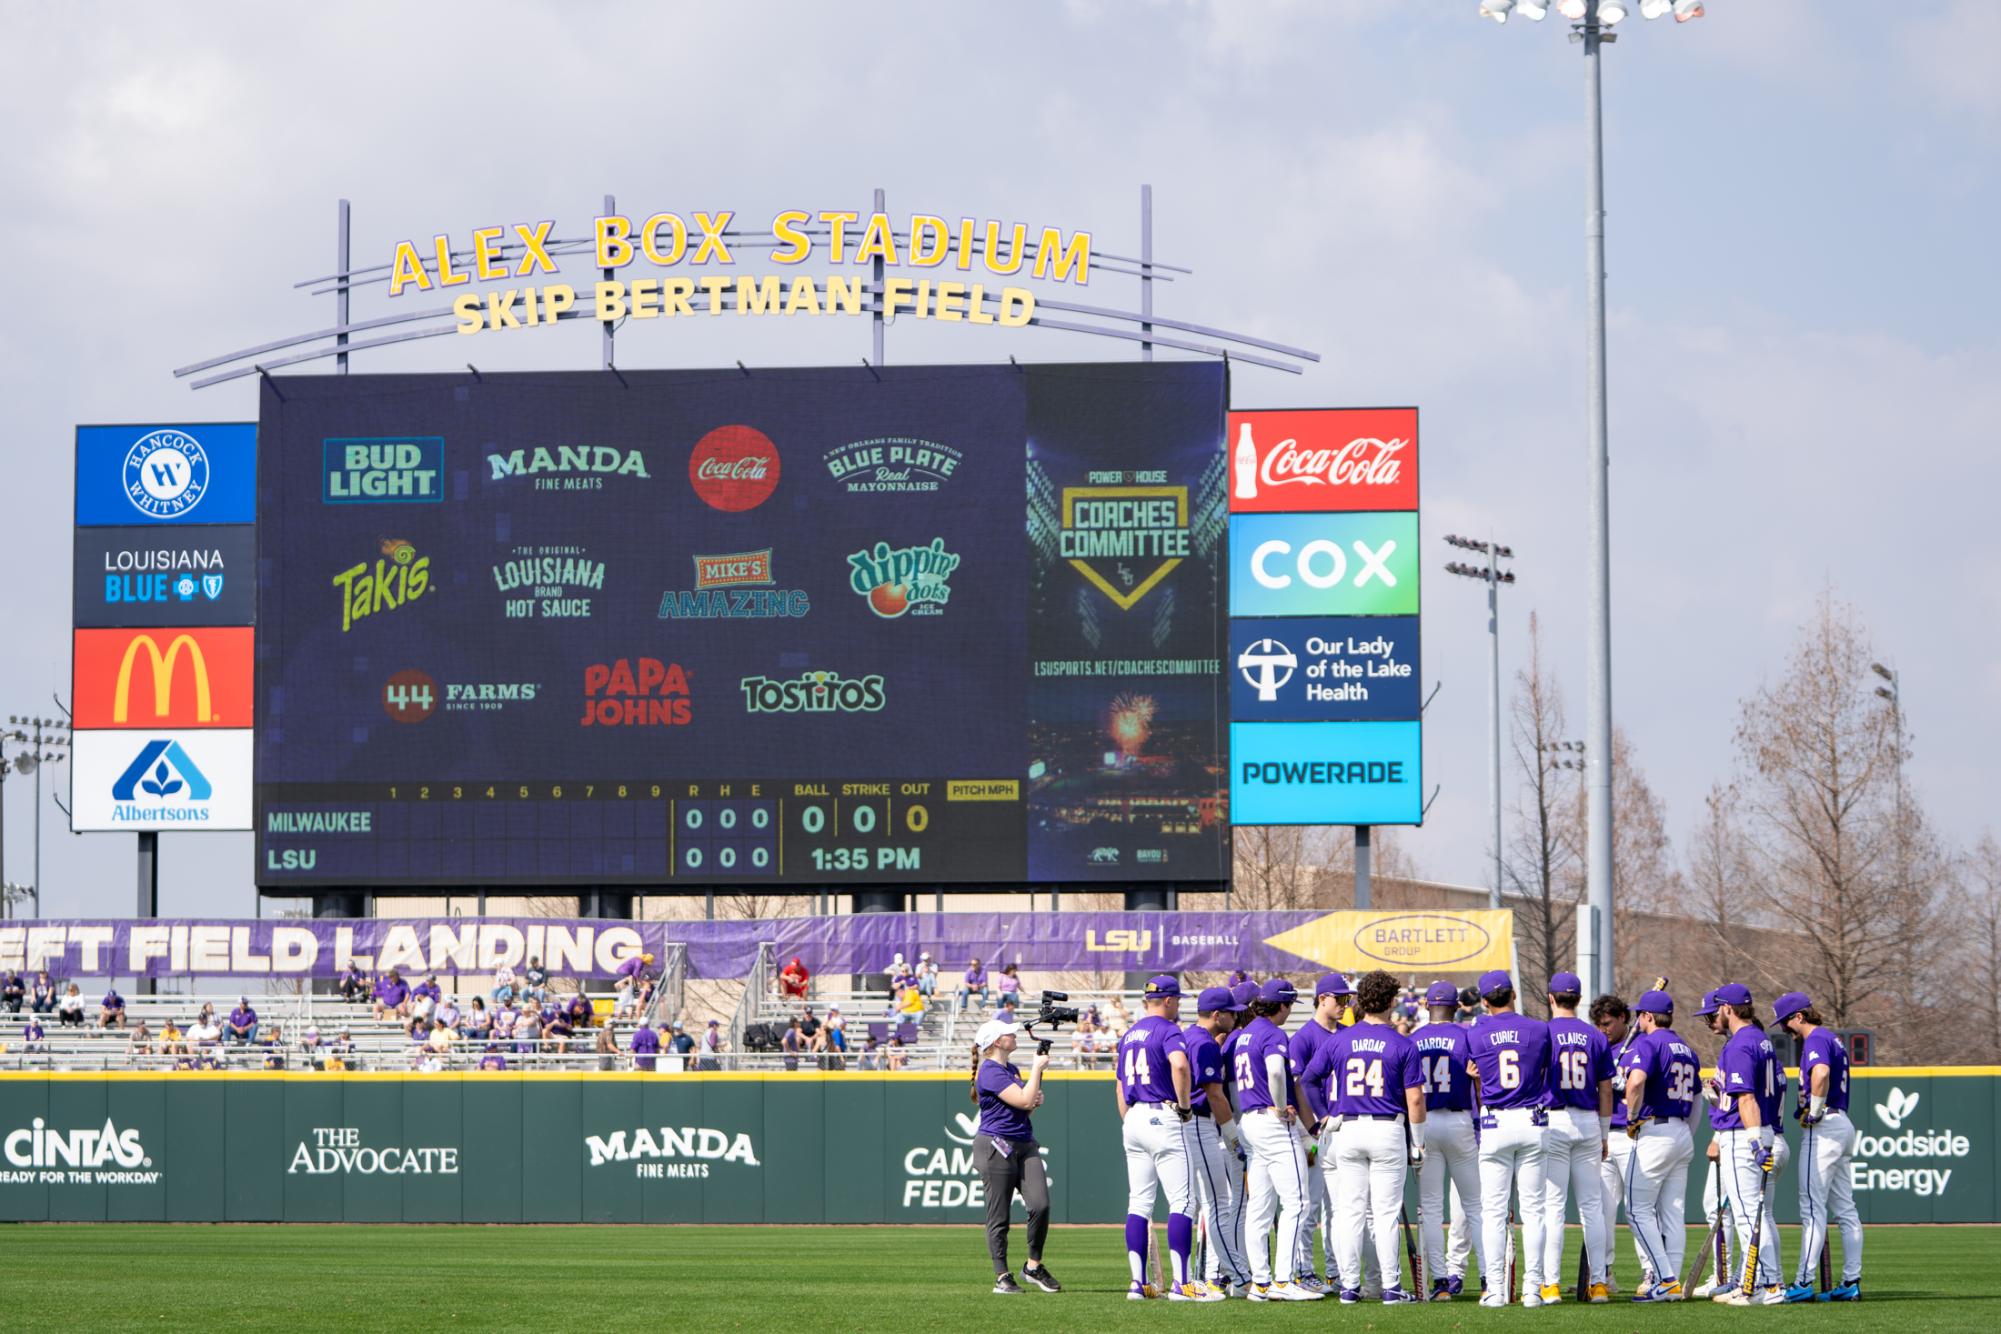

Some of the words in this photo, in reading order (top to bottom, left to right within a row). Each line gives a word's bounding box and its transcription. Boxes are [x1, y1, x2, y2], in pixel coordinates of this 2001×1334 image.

[388, 220, 560, 298] ALEX
[593, 211, 735, 270] BOX
[770, 210, 1093, 287] STADIUM
[452, 284, 576, 335] SKIP
[595, 275, 862, 321] BERTMAN
[883, 279, 1035, 327] FIELD
[129, 434, 202, 469] HANCOCK
[345, 444, 421, 470] BUD
[848, 439, 885, 449] ORLEANS
[920, 440, 963, 458] TRADITION
[487, 446, 646, 480] MANDA
[698, 456, 769, 480] Coca-Cola
[827, 447, 884, 478] BLUE
[890, 446, 958, 476] PLATE
[875, 466, 911, 481] Real
[1261, 438, 1409, 486] Coca-Cola
[330, 470, 435, 496] LIGHT
[535, 478, 562, 490] FINE
[564, 477, 602, 489] MEATS
[847, 481, 939, 492] MAYONNAISE
[1088, 471, 1122, 483] POWER
[1135, 471, 1167, 482] HOUSE
[129, 480, 202, 513] WHITNEY
[1075, 501, 1176, 528] COACHES
[518, 546, 533, 555] THE
[539, 546, 580, 554] ORIGINAL
[1060, 529, 1190, 557] COMMITTEE
[105, 549, 224, 571] LOUISIANA
[705, 561, 761, 579] MIKE'S
[1250, 539, 1398, 590] COX
[493, 557, 605, 592] LOUISIANA
[105, 574, 167, 602] BLUE
[534, 586, 562, 597] BRAND
[905, 581, 951, 604] dots
[506, 600, 535, 617] HOT
[542, 599, 591, 617] SAUCE
[657, 589, 810, 619] AMAZING
[1306, 637, 1343, 655] Our
[1348, 635, 1394, 659] Lady
[584, 657, 691, 696] PAPA
[1034, 659, 1220, 677] LSUSPORTS.NET/COACHESCOMMITTEE
[1306, 660, 1327, 677] of
[1331, 660, 1363, 677] the
[1367, 659, 1412, 677] Lake
[387, 685, 433, 710] 44
[446, 684, 535, 700] FARMS
[1306, 682, 1368, 701] Health
[580, 698, 693, 726] JOHNS
[1243, 761, 1403, 784] POWERADE
[390, 787, 397, 798] 1
[421, 787, 429, 799] 2
[453, 787, 462, 798] 3
[486, 787, 495, 798] 4
[520, 786, 528, 798] 5
[553, 786, 562, 798] 6
[586, 785, 593, 797] 7
[618, 785, 627, 797] 8
[651, 785, 660, 797] 9
[689, 785, 699, 797] R
[720, 785, 730, 796] H
[752, 784, 760, 796] E
[794, 784, 829, 796] BALL
[842, 783, 890, 796] STRIKE
[901, 783, 930, 795] OUT
[953, 784, 985, 796] PITCH
[988, 784, 1014, 795] MPH
[111, 804, 209, 823] Albertsons
[268, 812, 371, 833] MILWAUKEE
[686, 808, 702, 829] 0
[720, 808, 736, 829] 0
[752, 808, 768, 828] 0
[802, 805, 825, 833] 0
[853, 805, 876, 832] 0
[906, 804, 929, 832] 0
[268, 850, 316, 870] LSU
[686, 847, 702, 868] 0
[720, 847, 736, 868] 0
[752, 847, 768, 867] 0
[812, 847, 869, 870] 1:35
[878, 847, 920, 869] PM
[1086, 930, 1151, 951] LSU
[1172, 935, 1239, 945] BASEBALL
[1375, 929, 1468, 942] BARTLETT
[129, 926, 319, 972] FIELD
[335, 924, 643, 974] LANDING
[1384, 947, 1421, 956] GROUP
[1352, 1038, 1386, 1053] DARDAR
[1416, 1037, 1455, 1052] HARDEN
[1490, 1031, 1520, 1046] CURIEL
[1557, 1032, 1588, 1047] CLAUSS
[1124, 1047, 1151, 1086] 44
[1235, 1052, 1255, 1092] 23
[1346, 1058, 1384, 1097] 24
[1421, 1056, 1451, 1093] 14
[1499, 1050, 1520, 1089] 6
[1559, 1051, 1588, 1090] 16
[1667, 1062, 1695, 1102] 32
[312, 1128, 360, 1147] THE
[584, 1126, 756, 1167] MANDA
[287, 1141, 459, 1174] ADVOCATE
[40, 1171, 65, 1184] FOR
[68, 1171, 92, 1184] THE
[95, 1171, 159, 1184] WORKDAY
[636, 1163, 665, 1179] FINE
[667, 1163, 710, 1179] MEATS
[1850, 1162, 1952, 1196] Energy
